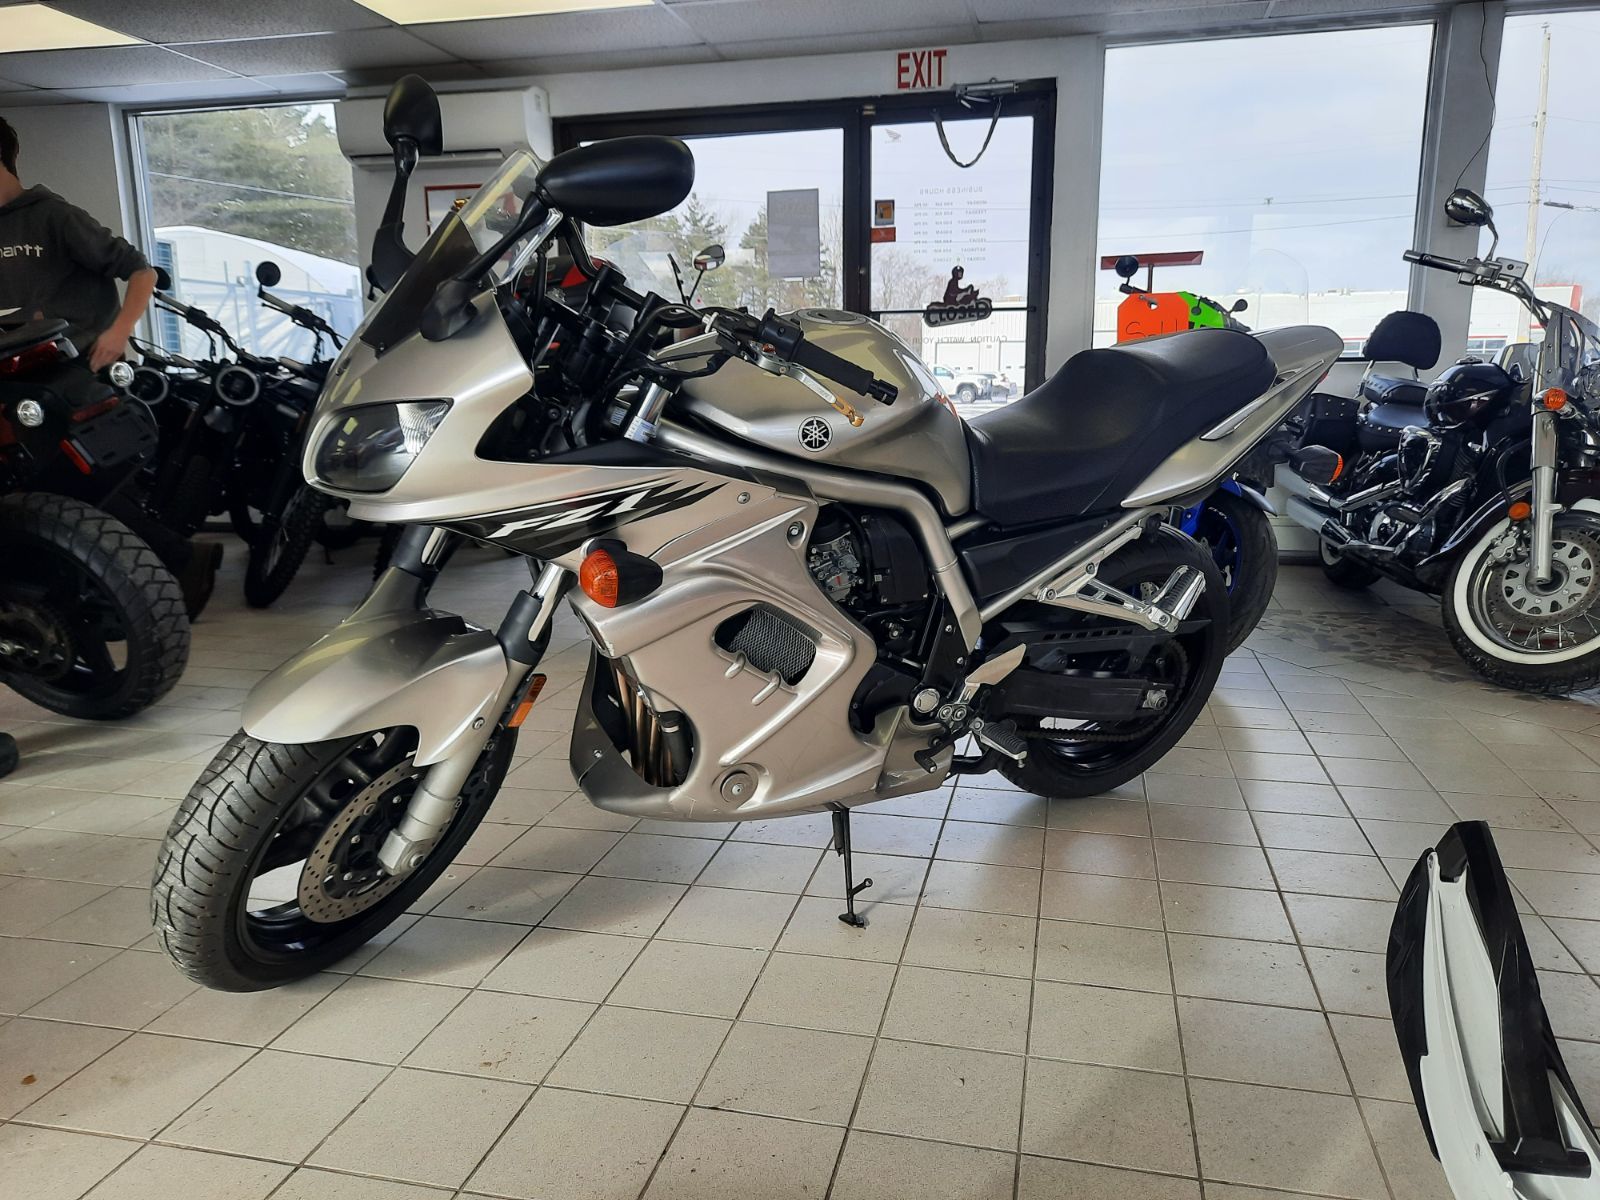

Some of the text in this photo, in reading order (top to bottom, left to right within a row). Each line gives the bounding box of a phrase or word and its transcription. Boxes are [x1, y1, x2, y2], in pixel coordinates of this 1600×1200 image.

[897, 50, 947, 89] EXIT
[924, 301, 990, 325] CLOSED
[485, 488, 652, 539] FZ1
